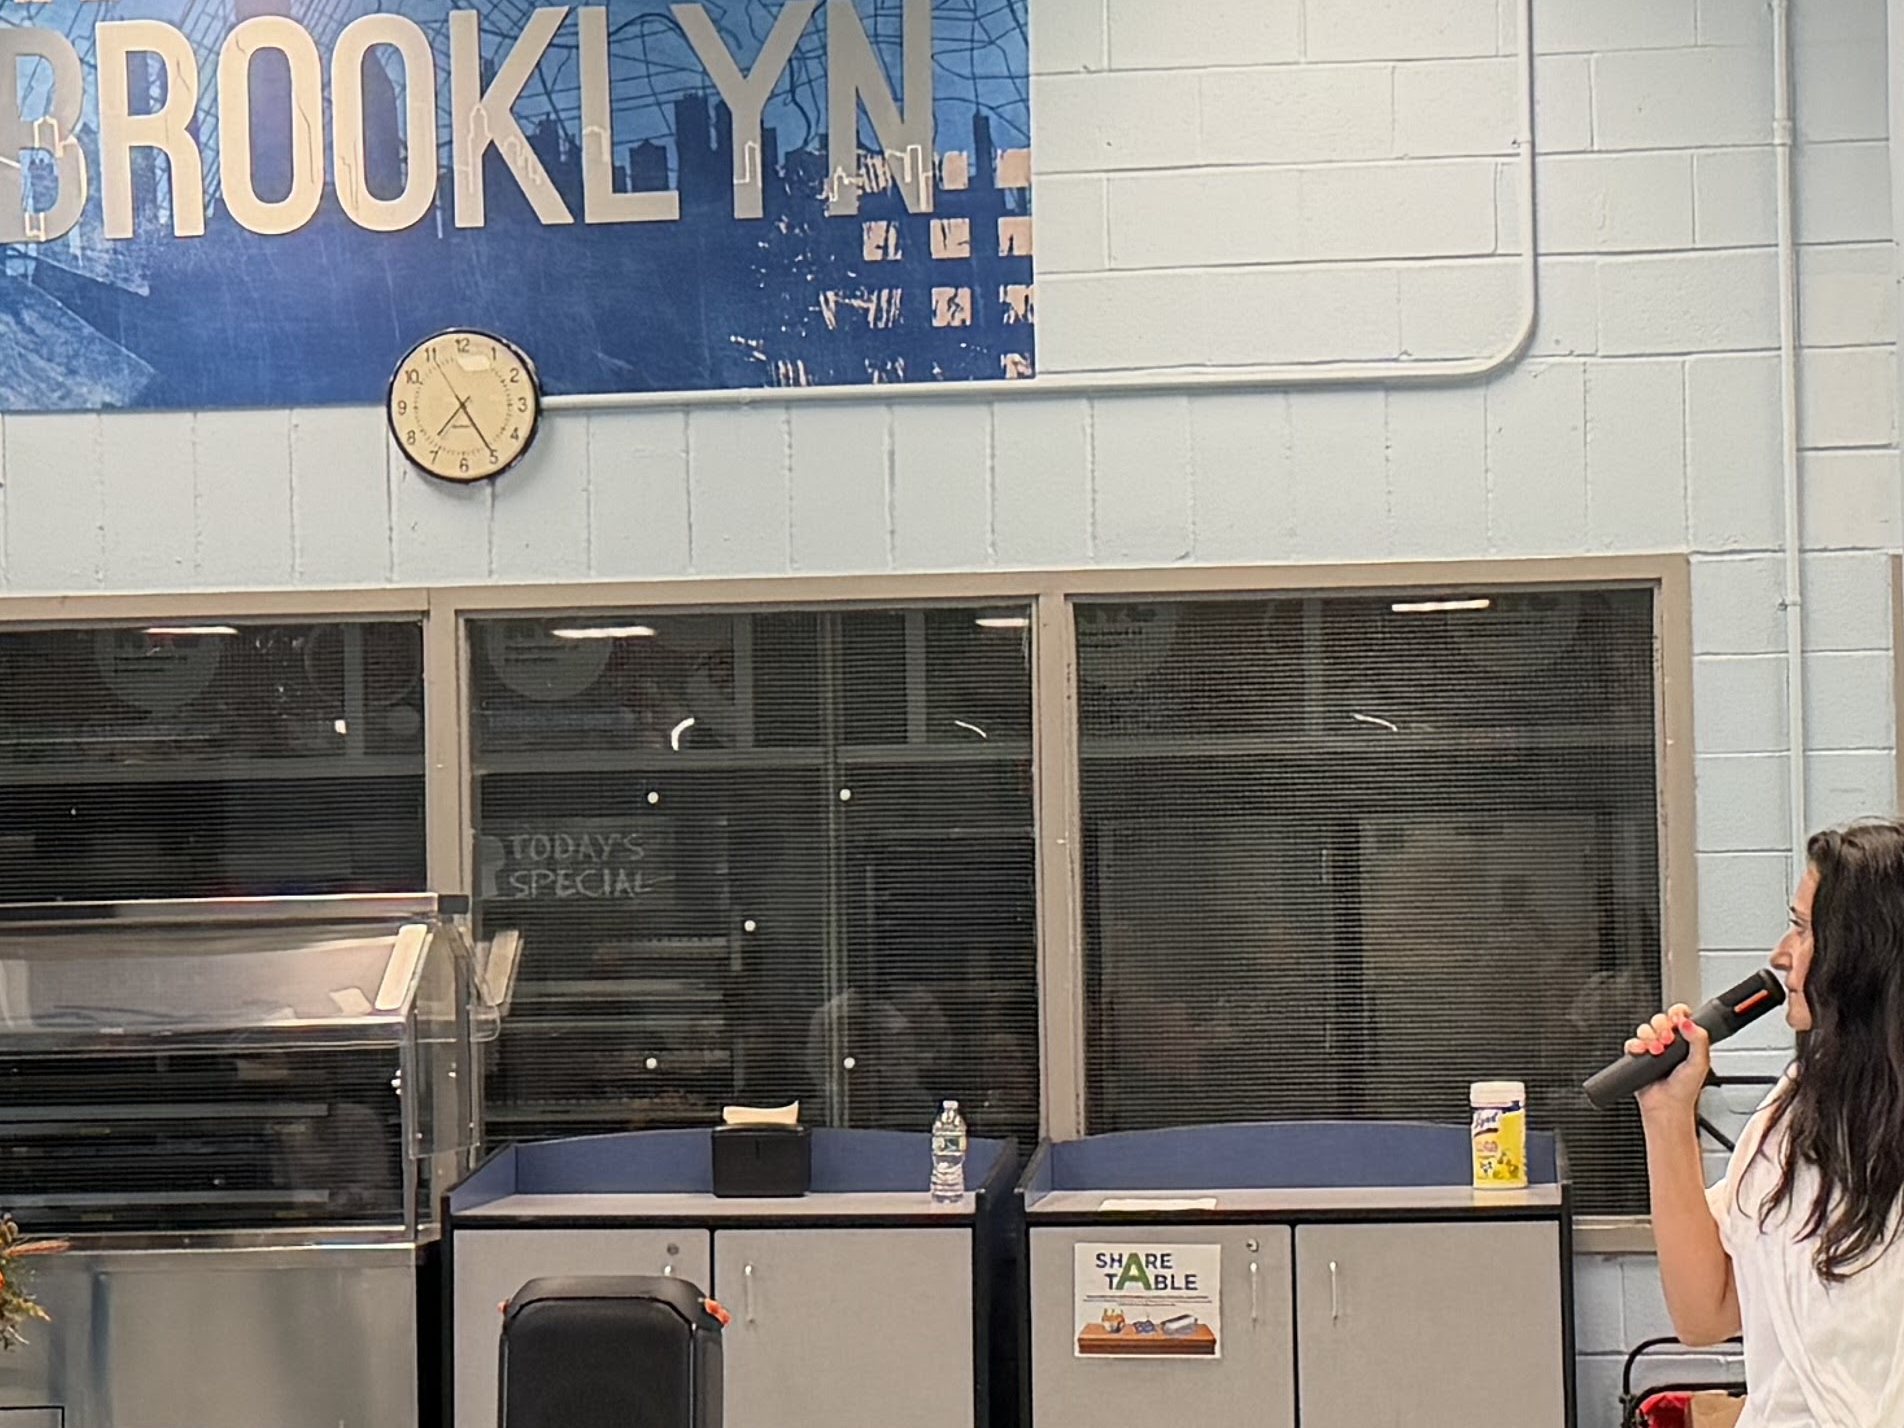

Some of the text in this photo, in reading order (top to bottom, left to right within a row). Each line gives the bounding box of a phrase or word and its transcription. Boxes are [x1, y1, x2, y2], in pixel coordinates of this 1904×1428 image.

[454, 337, 470, 354] 12
[508, 367, 520, 383] 2
[397, 399, 407, 416] 9
[517, 397, 528, 413] 3
[458, 457, 469, 473] 6
[489, 448, 499, 465] 5
[507, 833, 644, 862] TODAY'S
[508, 868, 671, 901] SPECIAL
[1095, 1252, 1173, 1274] SHARE
[1103, 1269, 1199, 1291] TABLE
